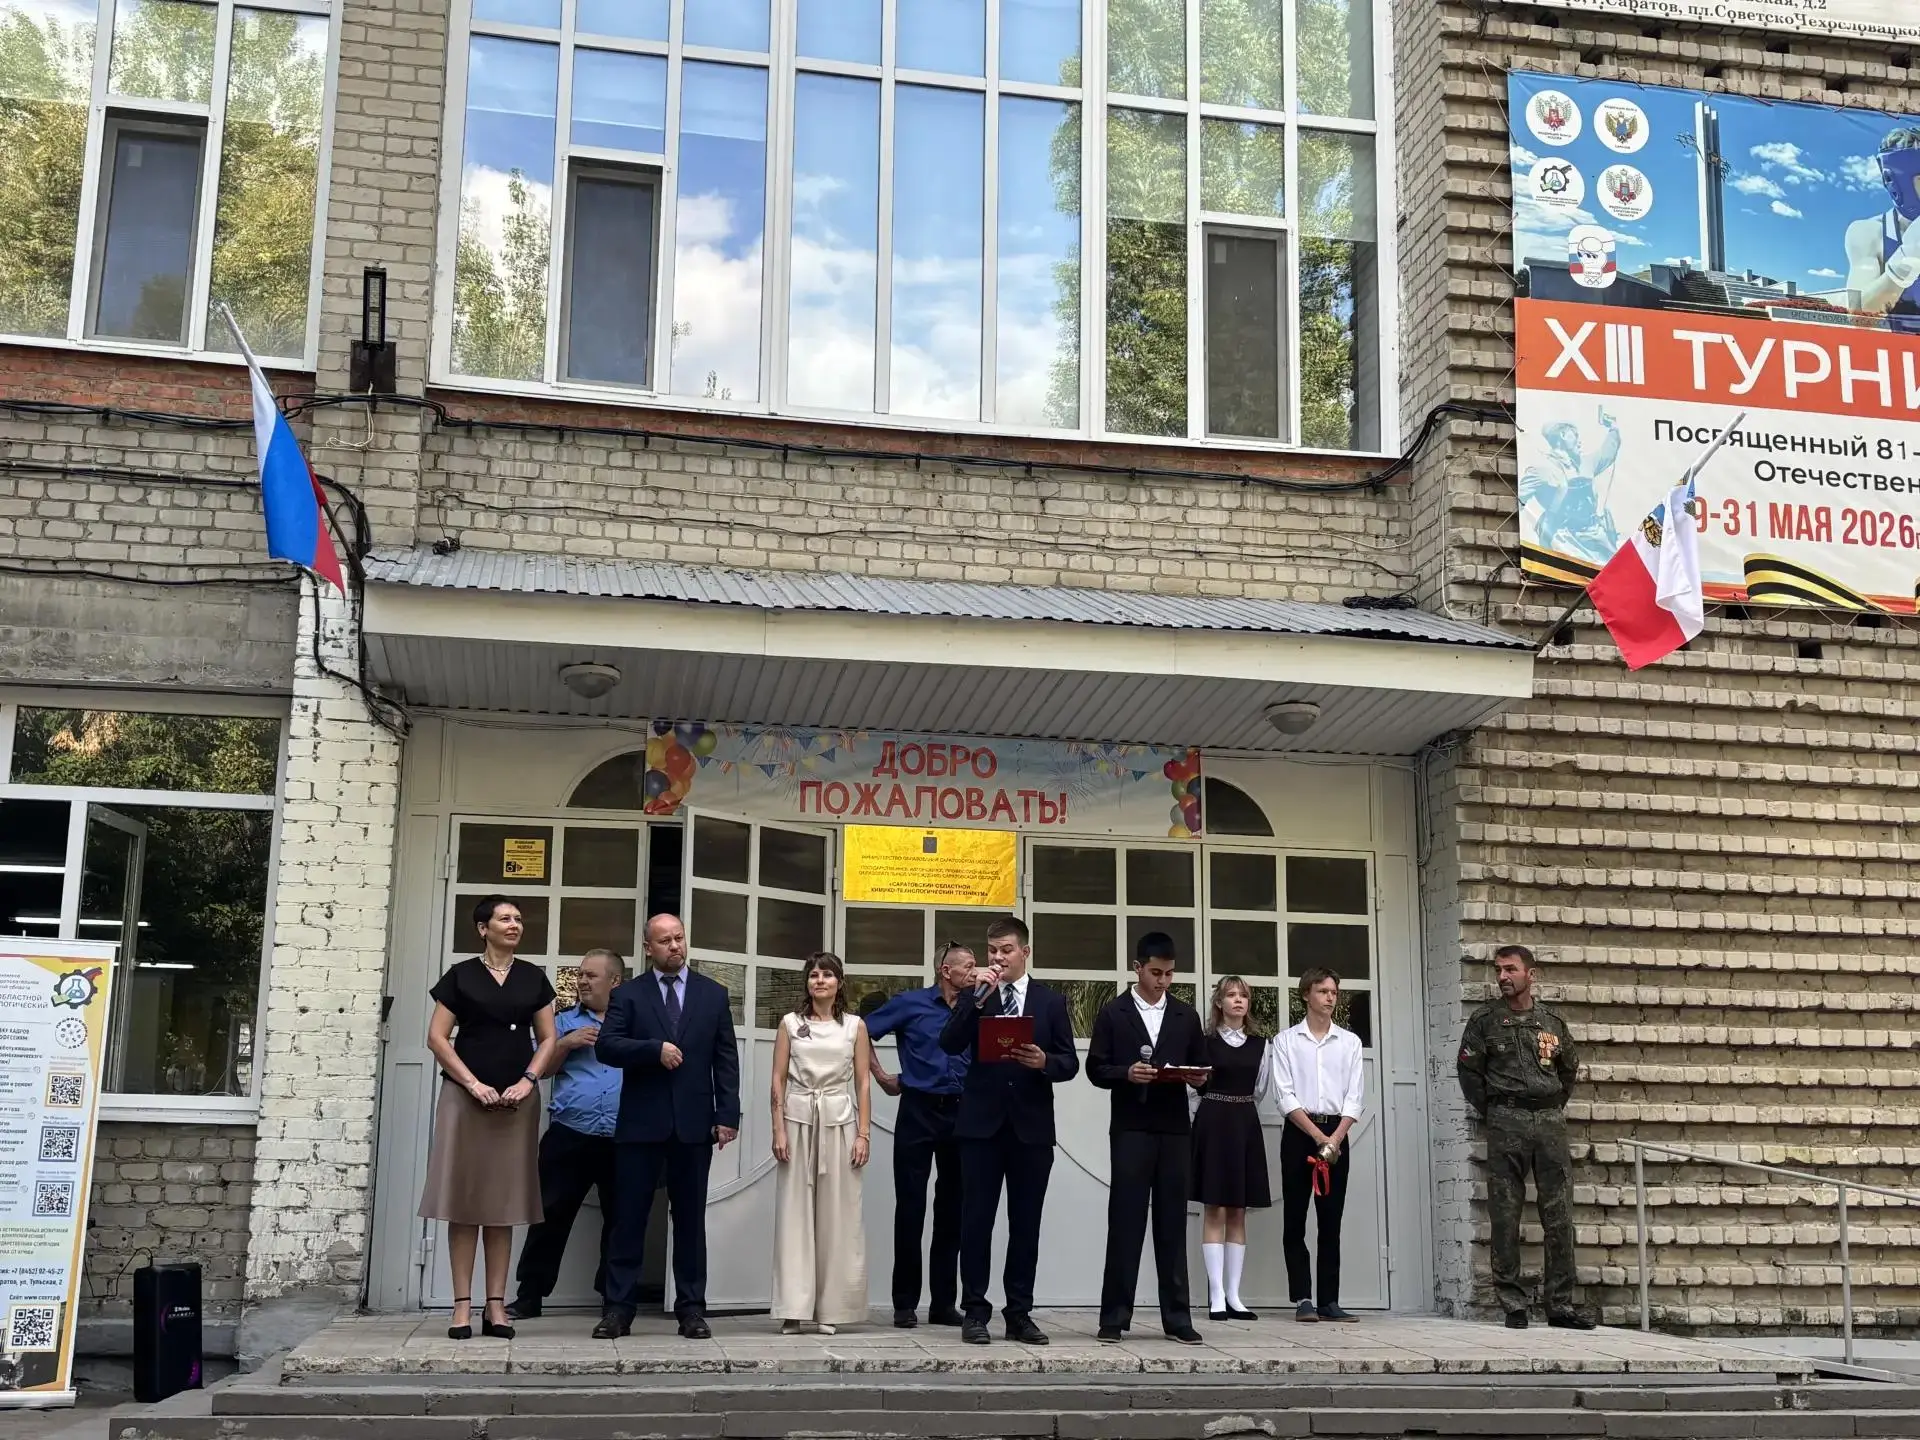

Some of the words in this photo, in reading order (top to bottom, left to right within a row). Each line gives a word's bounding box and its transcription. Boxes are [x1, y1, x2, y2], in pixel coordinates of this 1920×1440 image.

[1687, 4, 1920, 38] пл.СоветскоЧехословацко
[1768, 502, 1833, 543] МАЯ
[872, 740, 998, 779] ДОБРО
[799, 780, 1068, 825] ПОЖАЛОВАТЬ!
